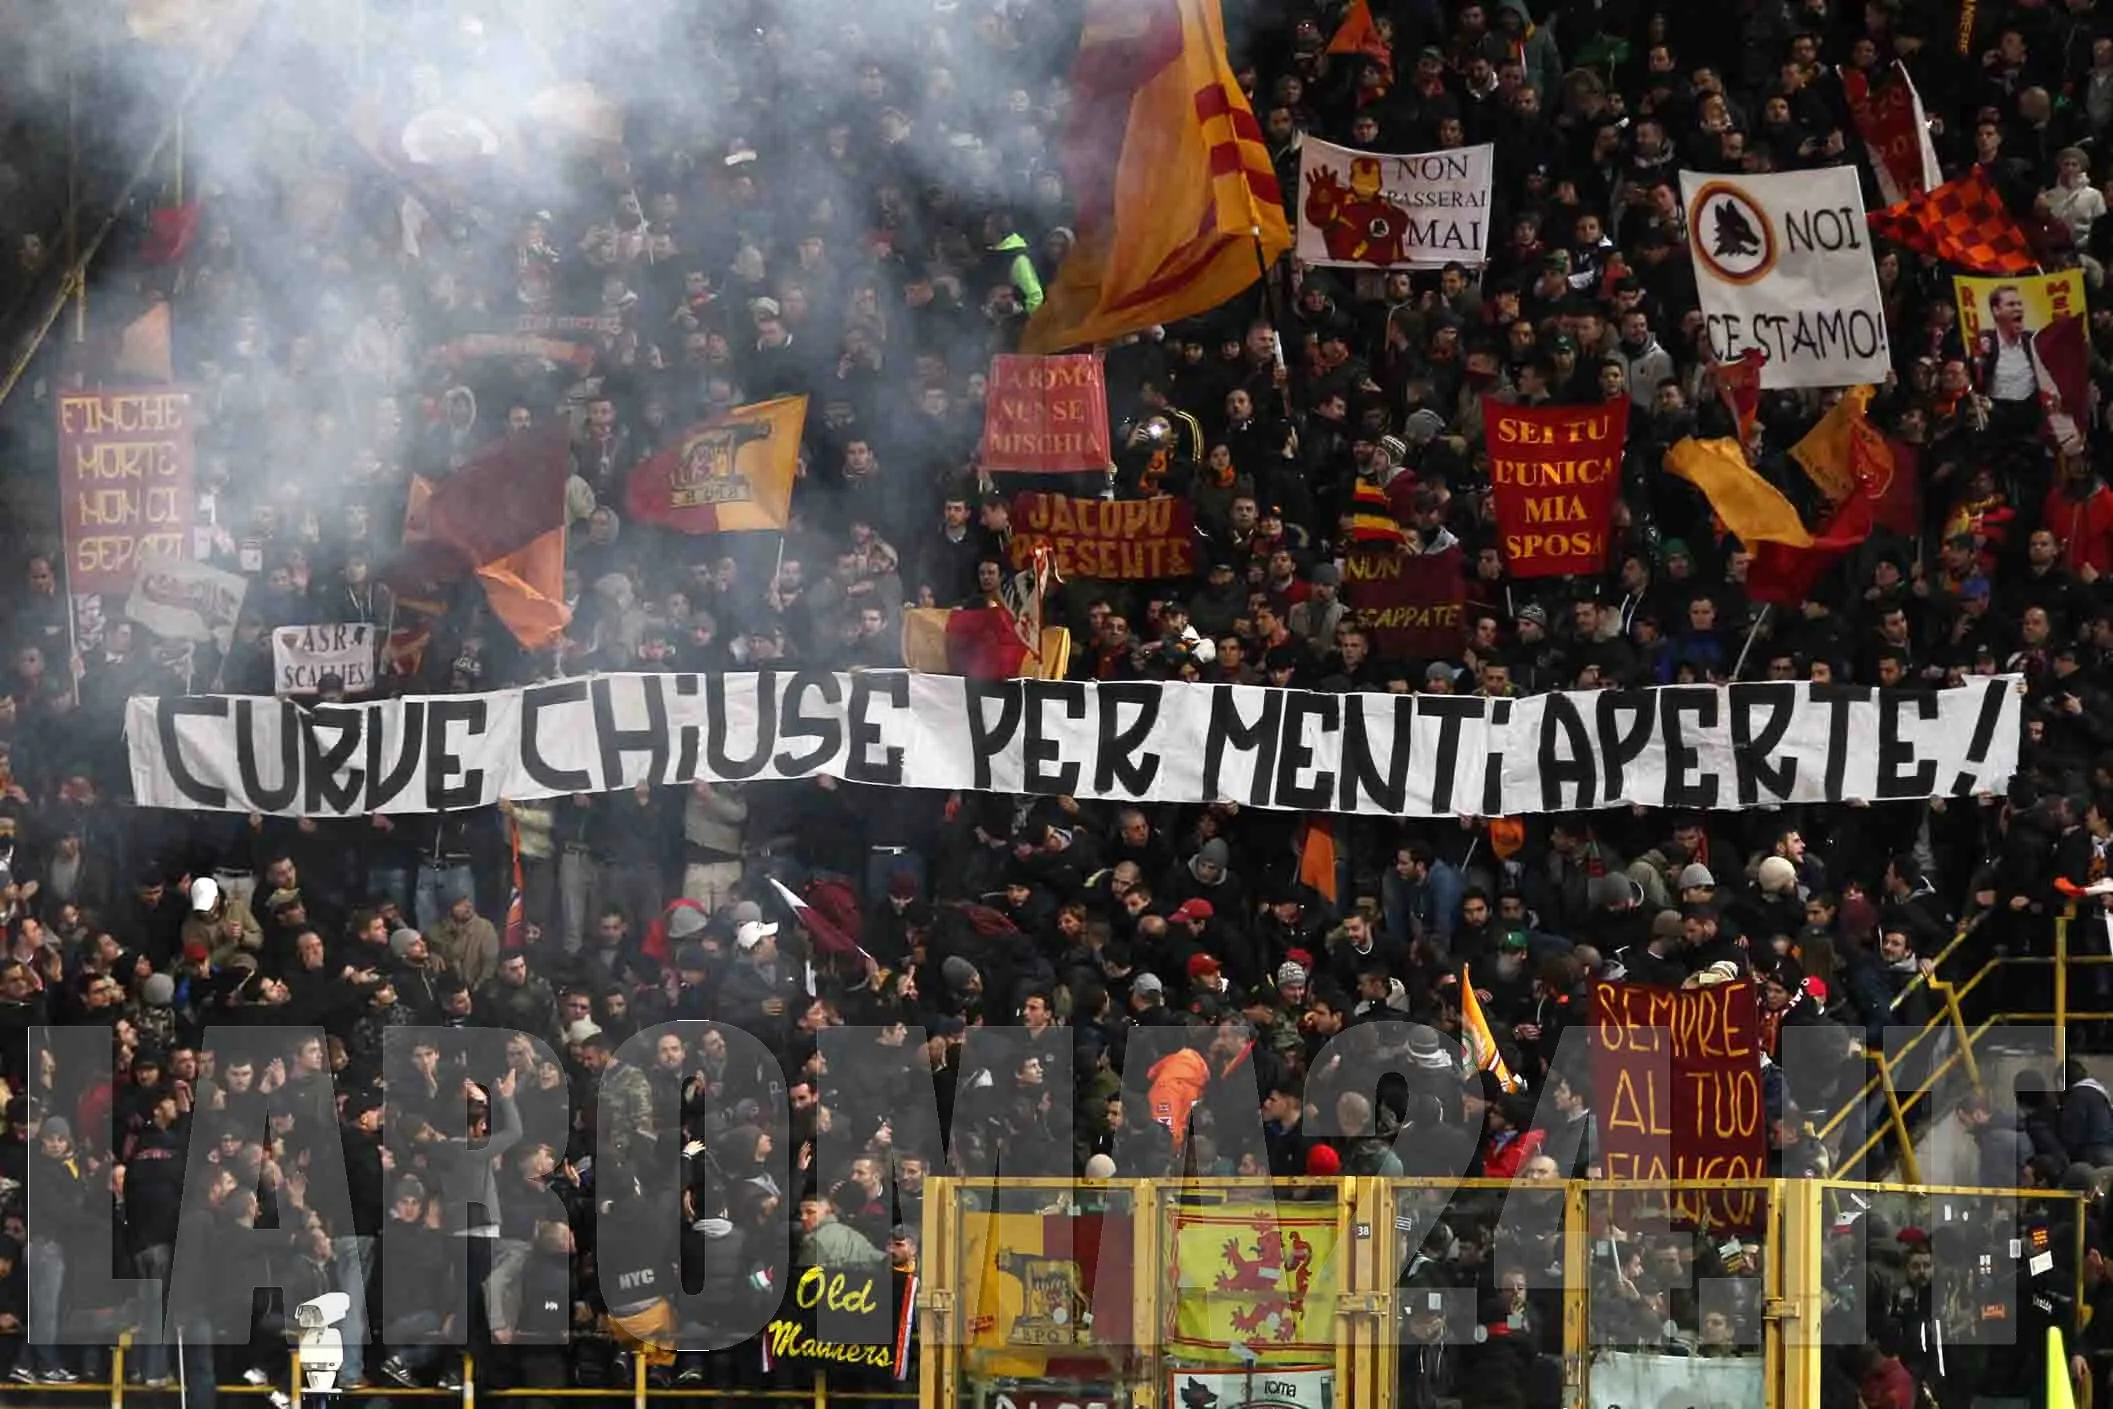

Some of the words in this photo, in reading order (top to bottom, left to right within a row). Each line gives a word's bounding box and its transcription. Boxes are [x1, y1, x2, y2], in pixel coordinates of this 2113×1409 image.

[1397, 156, 1469, 181] NON
[1406, 219, 1482, 251] MAI
[1785, 207, 1861, 252] NOI
[1706, 314, 1741, 362] CE
[1753, 309, 1887, 362] STAMO!
[1052, 400, 1085, 424] SE
[1498, 417, 1555, 444] SEI
[1563, 414, 1612, 442] TU
[1523, 494, 1588, 524] MIA
[1009, 533, 1194, 579] PESENTE
[302, 624, 347, 652] ASR
[157, 698, 488, 816] CURVE
[965, 677, 1163, 797] PER
[1538, 679, 2008, 810] APERTE!
[1597, 983, 1750, 1059] SEMPRE
[1609, 1069, 1673, 1135] AL
[1686, 1071, 1759, 1139] TUO
[618, 1268, 656, 1291] NYC
[796, 1266, 877, 1314] Old
[1264, 1380, 1297, 1398] roma
